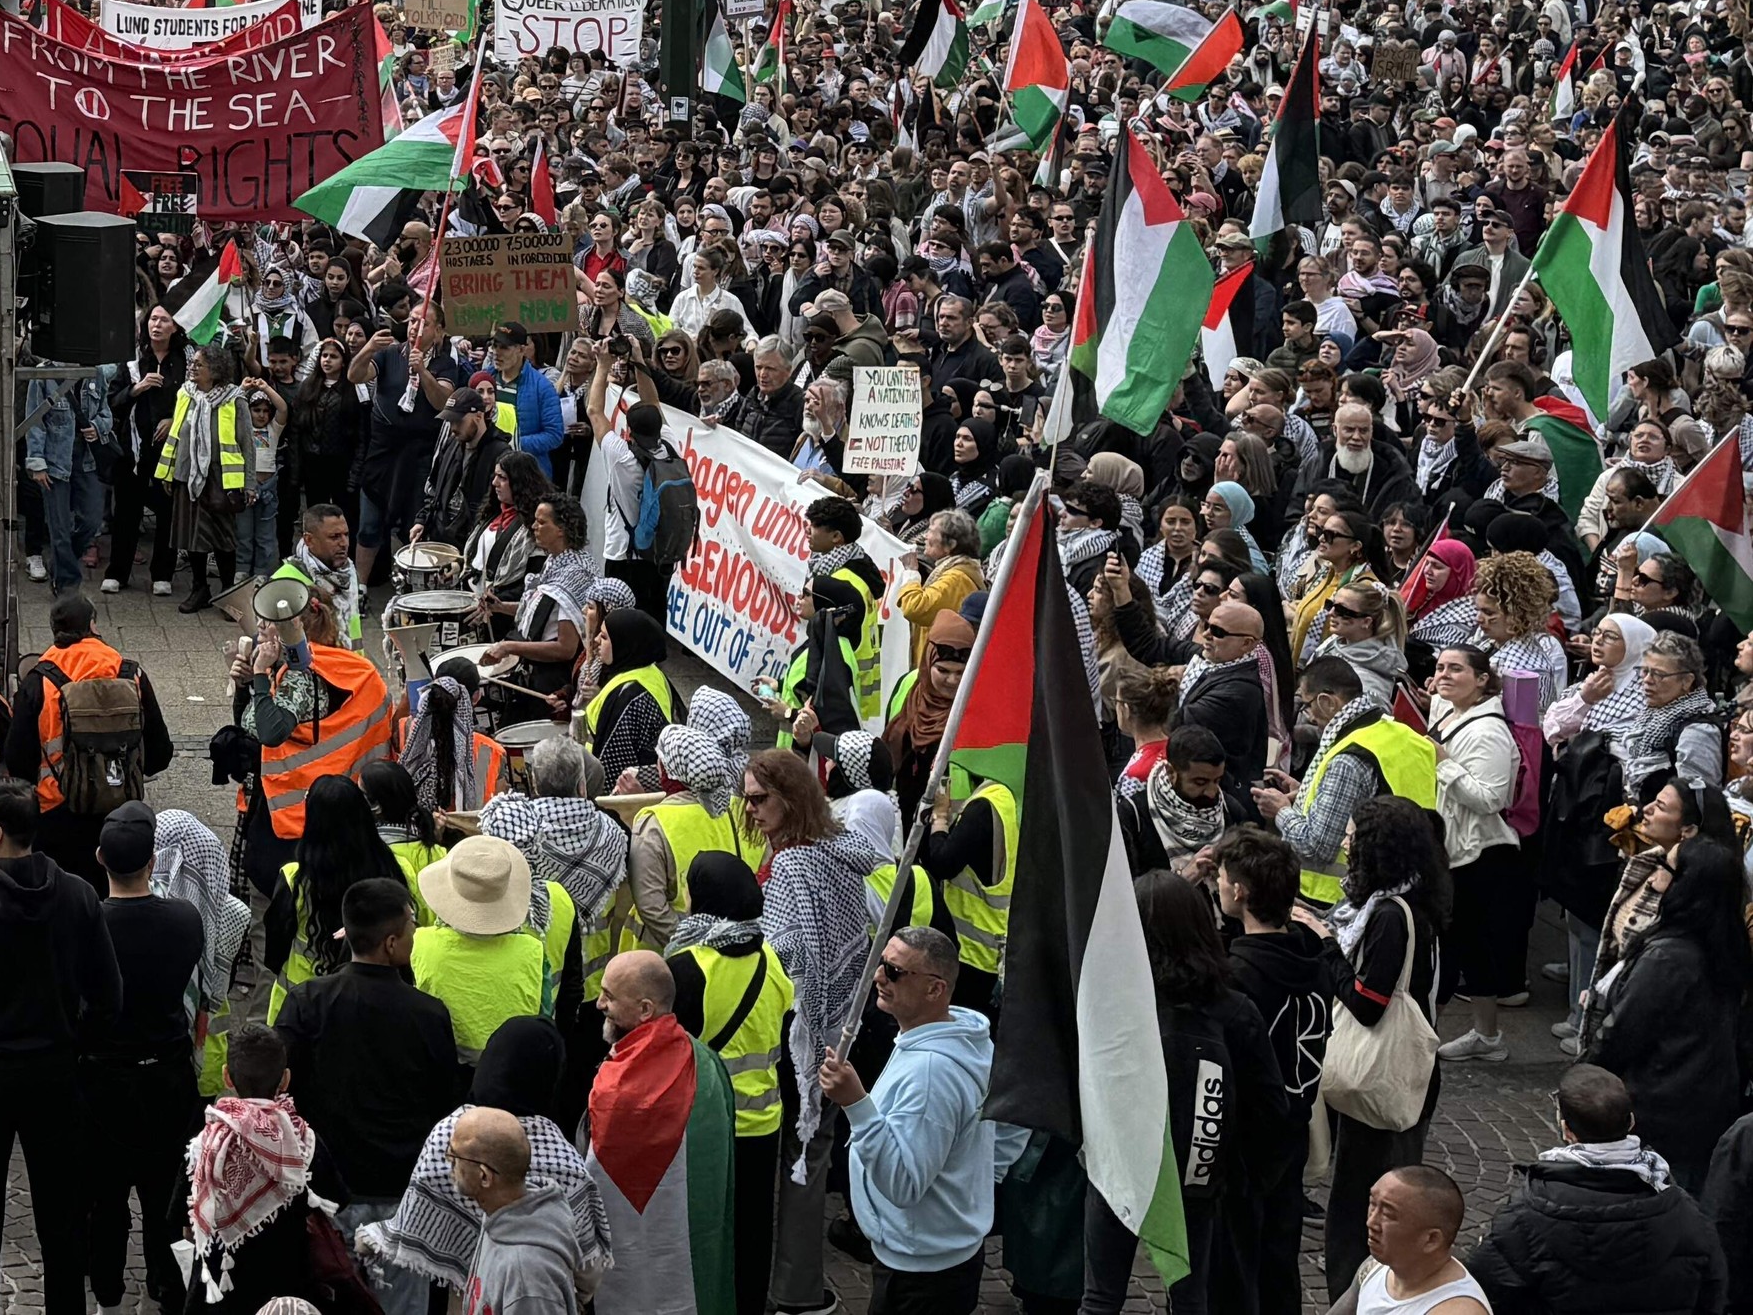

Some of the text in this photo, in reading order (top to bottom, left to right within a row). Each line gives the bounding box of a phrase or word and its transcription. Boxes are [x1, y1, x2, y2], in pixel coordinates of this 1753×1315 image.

[116, 13, 148, 35] LUND
[153, 18, 219, 37] STUDENTS
[222, 16, 249, 34] FOR
[516, 14, 629, 58] STOP
[3, 20, 115, 85] FROM
[227, 34, 347, 86] RIVER
[36, 71, 317, 131] TO THE SEA
[445, 253, 494, 267] HOSTAGES
[507, 254, 519, 266] IN
[449, 266, 569, 298] BRING THEM
[865, 370, 886, 385] YOU
[868, 386, 876, 403] A
[859, 412, 890, 429] KNOWS
[864, 435, 888, 453] NOT
[851, 456, 906, 470] FREE PALESTINE
[680, 537, 799, 645] GENOCIDE
[727, 628, 755, 674] OF
[1193, 1077, 1223, 1179] adidas
